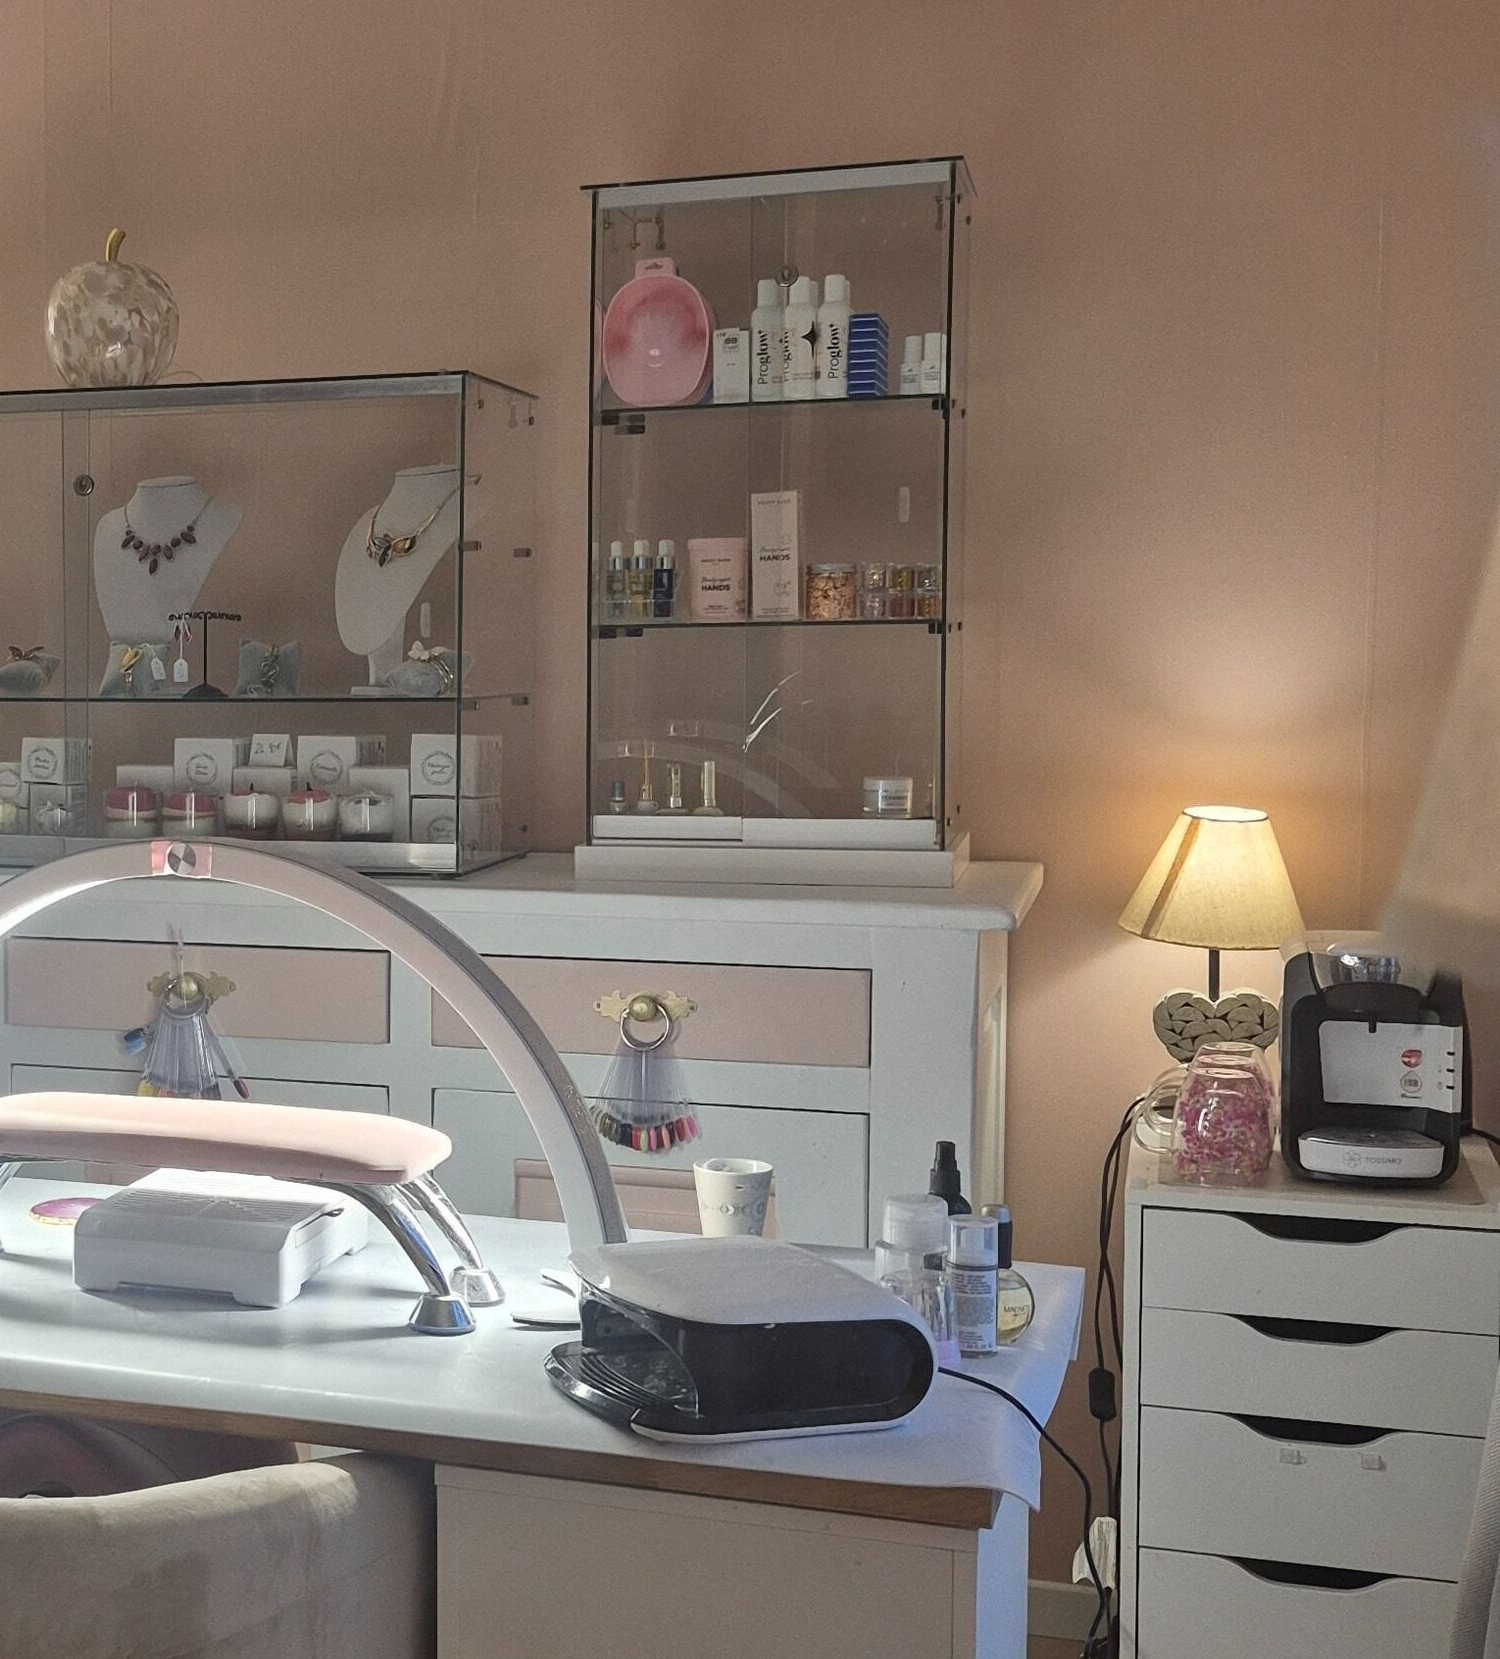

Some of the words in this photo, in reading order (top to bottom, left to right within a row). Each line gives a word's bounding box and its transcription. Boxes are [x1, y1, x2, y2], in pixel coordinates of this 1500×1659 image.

[756, 331, 772, 385] Proglow
[825, 326, 843, 379] Proglow
[760, 554, 790, 562] HANDS
[701, 584, 731, 592] HANDS
